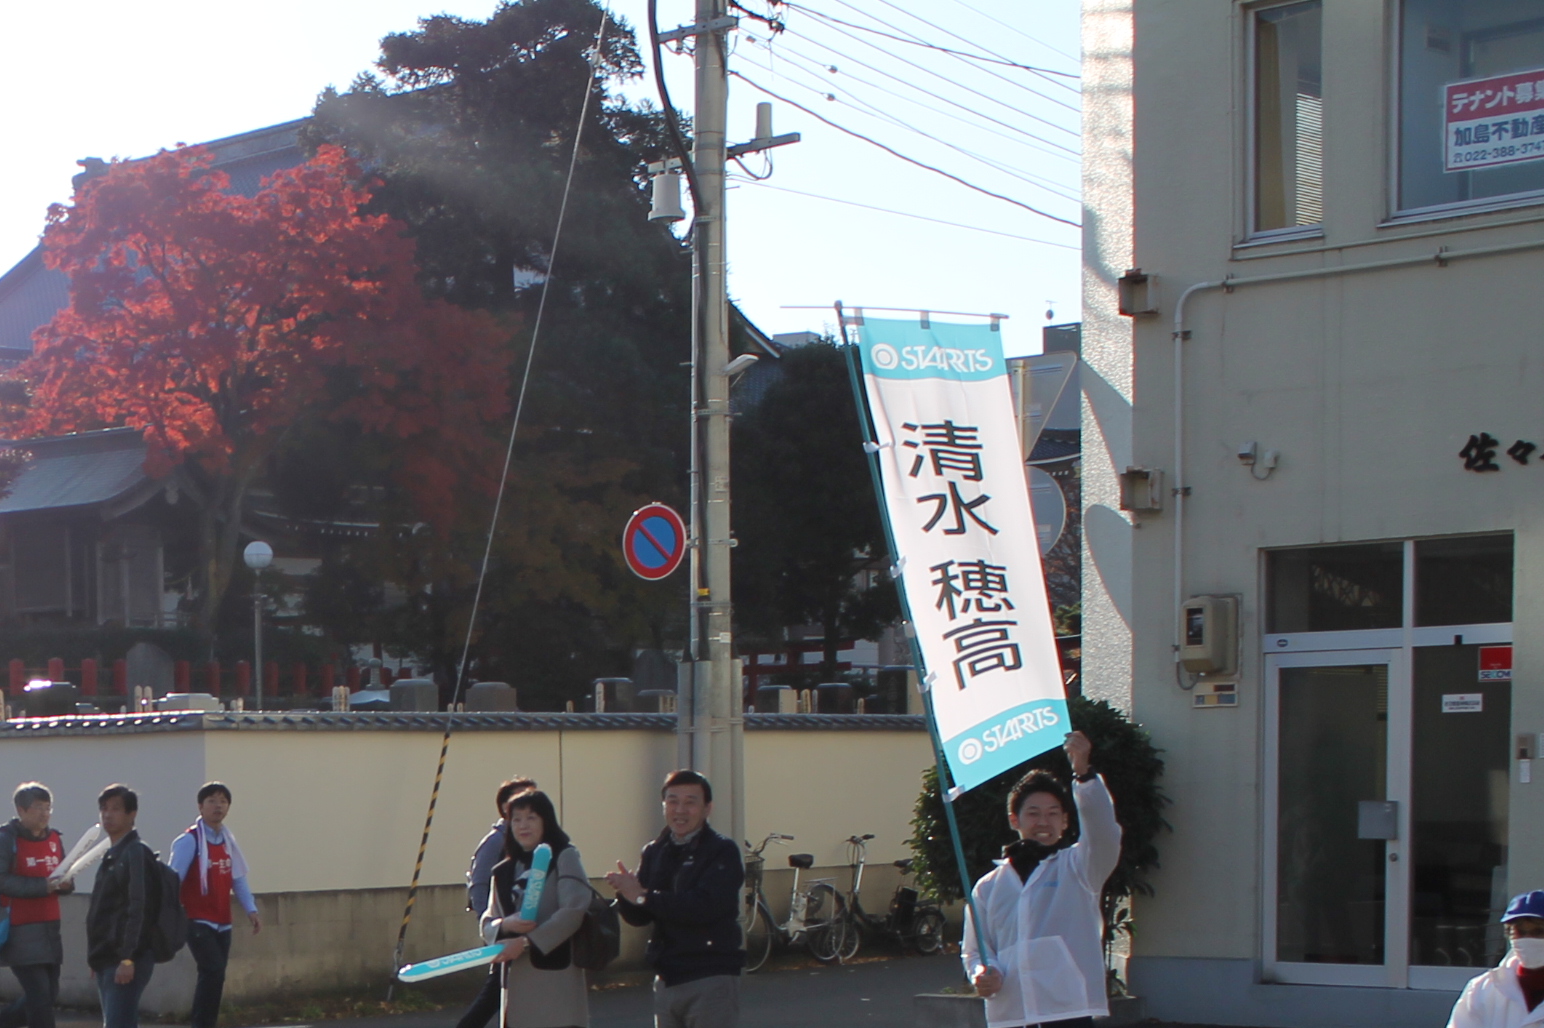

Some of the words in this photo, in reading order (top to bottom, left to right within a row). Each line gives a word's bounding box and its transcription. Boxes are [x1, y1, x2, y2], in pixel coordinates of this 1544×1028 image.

[1454, 114, 1544, 147] 加島不動産
[1465, 140, 1544, 162] 022-388-374
[901, 345, 994, 373] STARTS
[1458, 431, 1544, 473] 佐々
[899, 419, 1000, 537] 清水
[929, 558, 1024, 692] 穂高
[1481, 669, 1512, 679] SECOM
[982, 706, 1059, 753] STARTS
